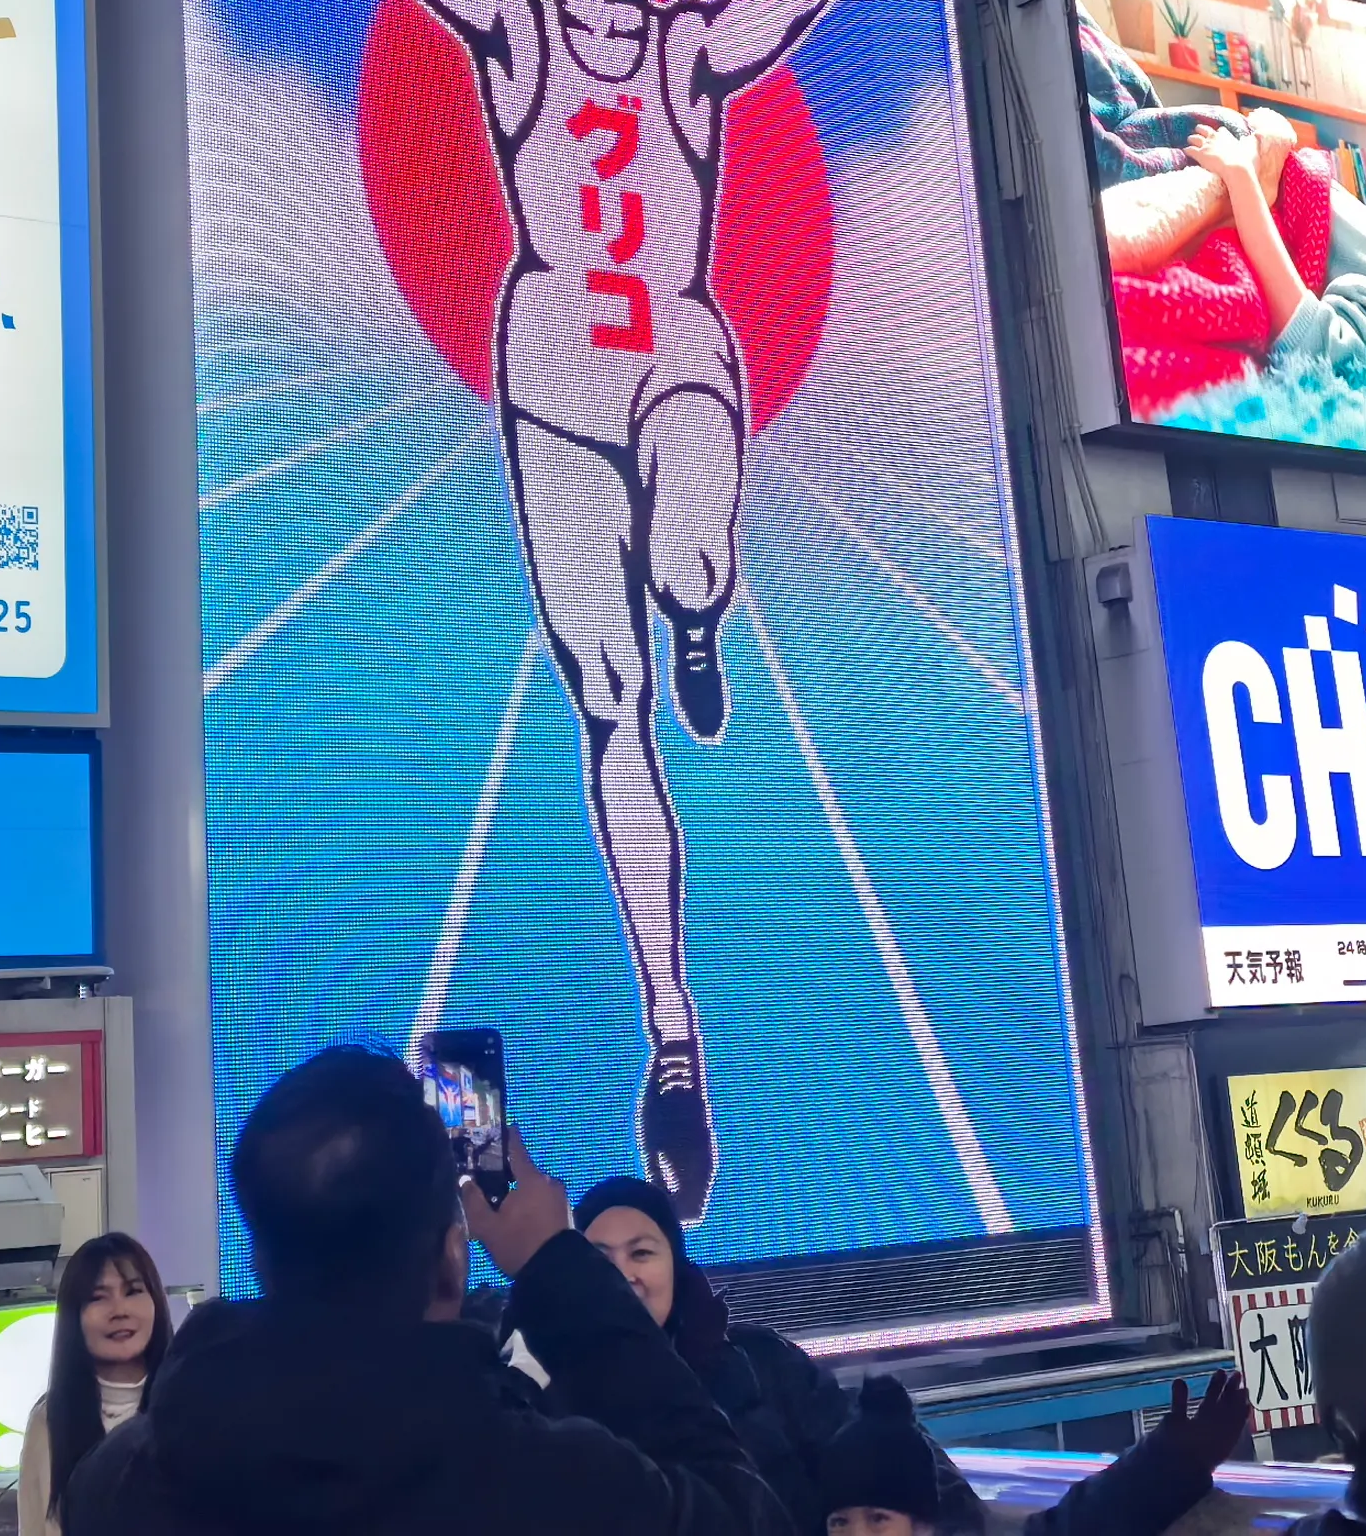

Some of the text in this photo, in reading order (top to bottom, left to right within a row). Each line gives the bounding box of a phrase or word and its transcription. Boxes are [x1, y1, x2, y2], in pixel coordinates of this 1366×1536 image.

[564, 94, 656, 355] グリコ
[1224, 948, 1305, 985] 天気予報
[1239, 1088, 1271, 1205] 道頓堀
[1266, 1088, 1364, 1192] くくる
[1306, 1193, 1341, 1209] KUKURU
